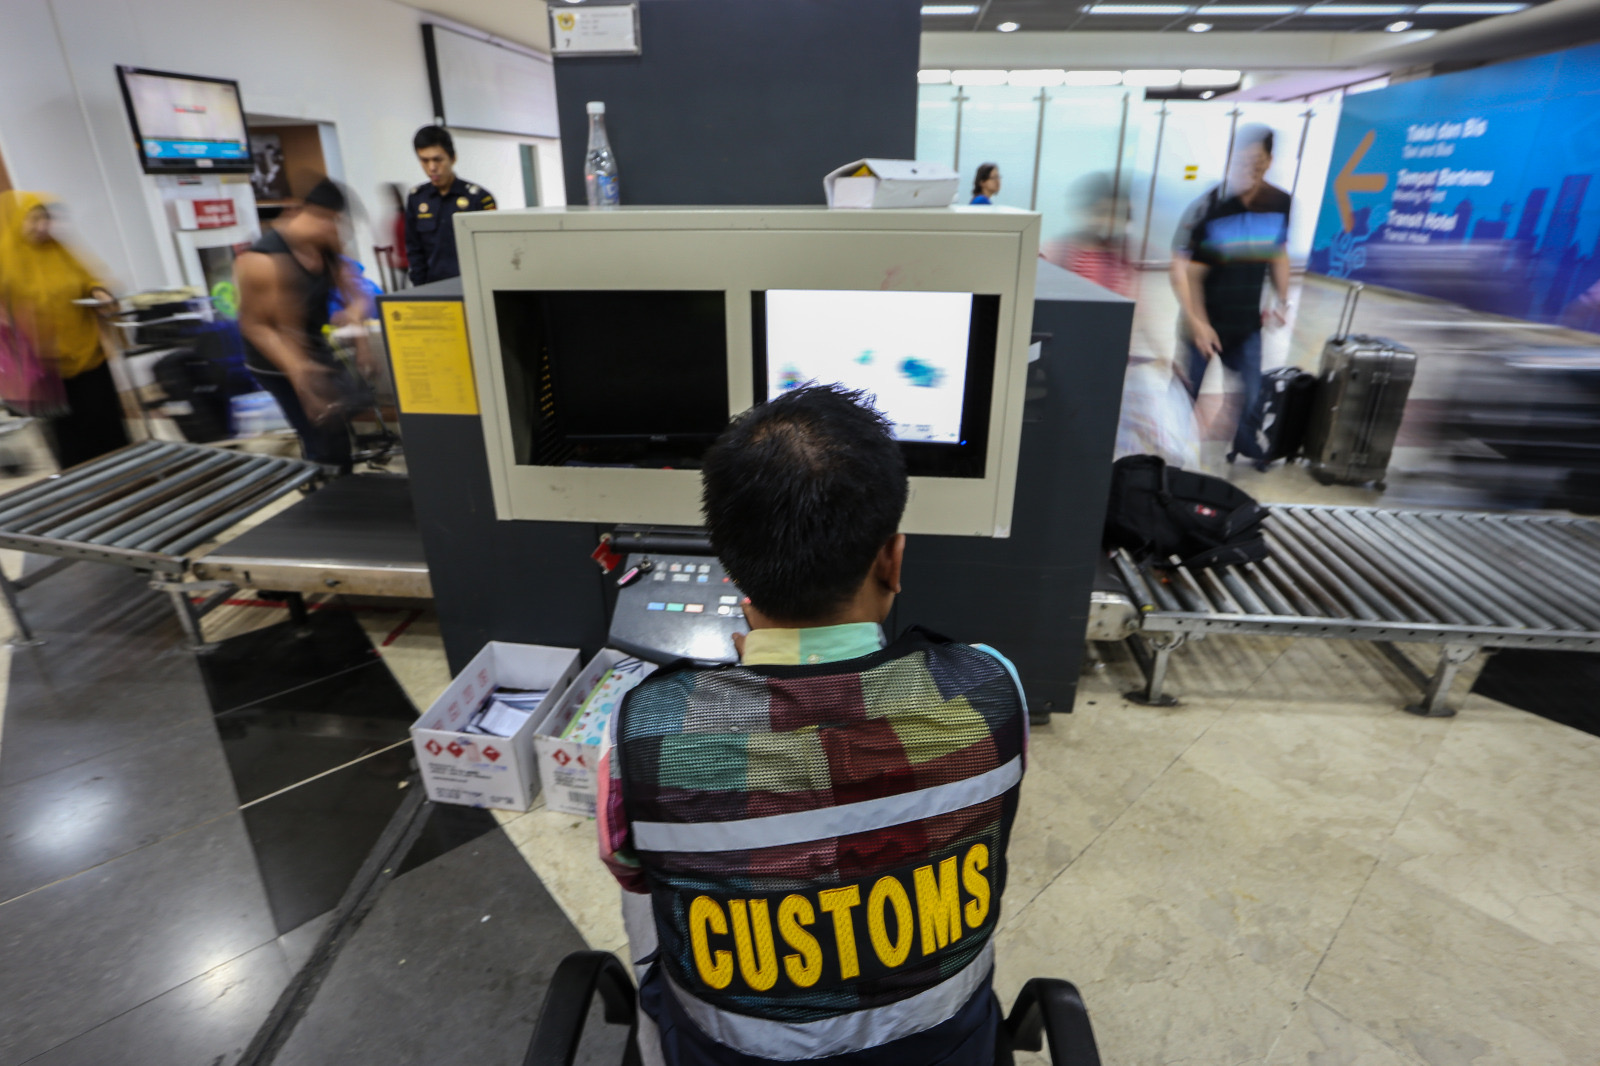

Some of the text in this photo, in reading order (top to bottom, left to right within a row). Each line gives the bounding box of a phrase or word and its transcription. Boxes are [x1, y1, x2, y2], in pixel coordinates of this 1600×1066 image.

[1388, 209, 1459, 231] Transit Hotel
[689, 843, 991, 991] CUSTOMS
